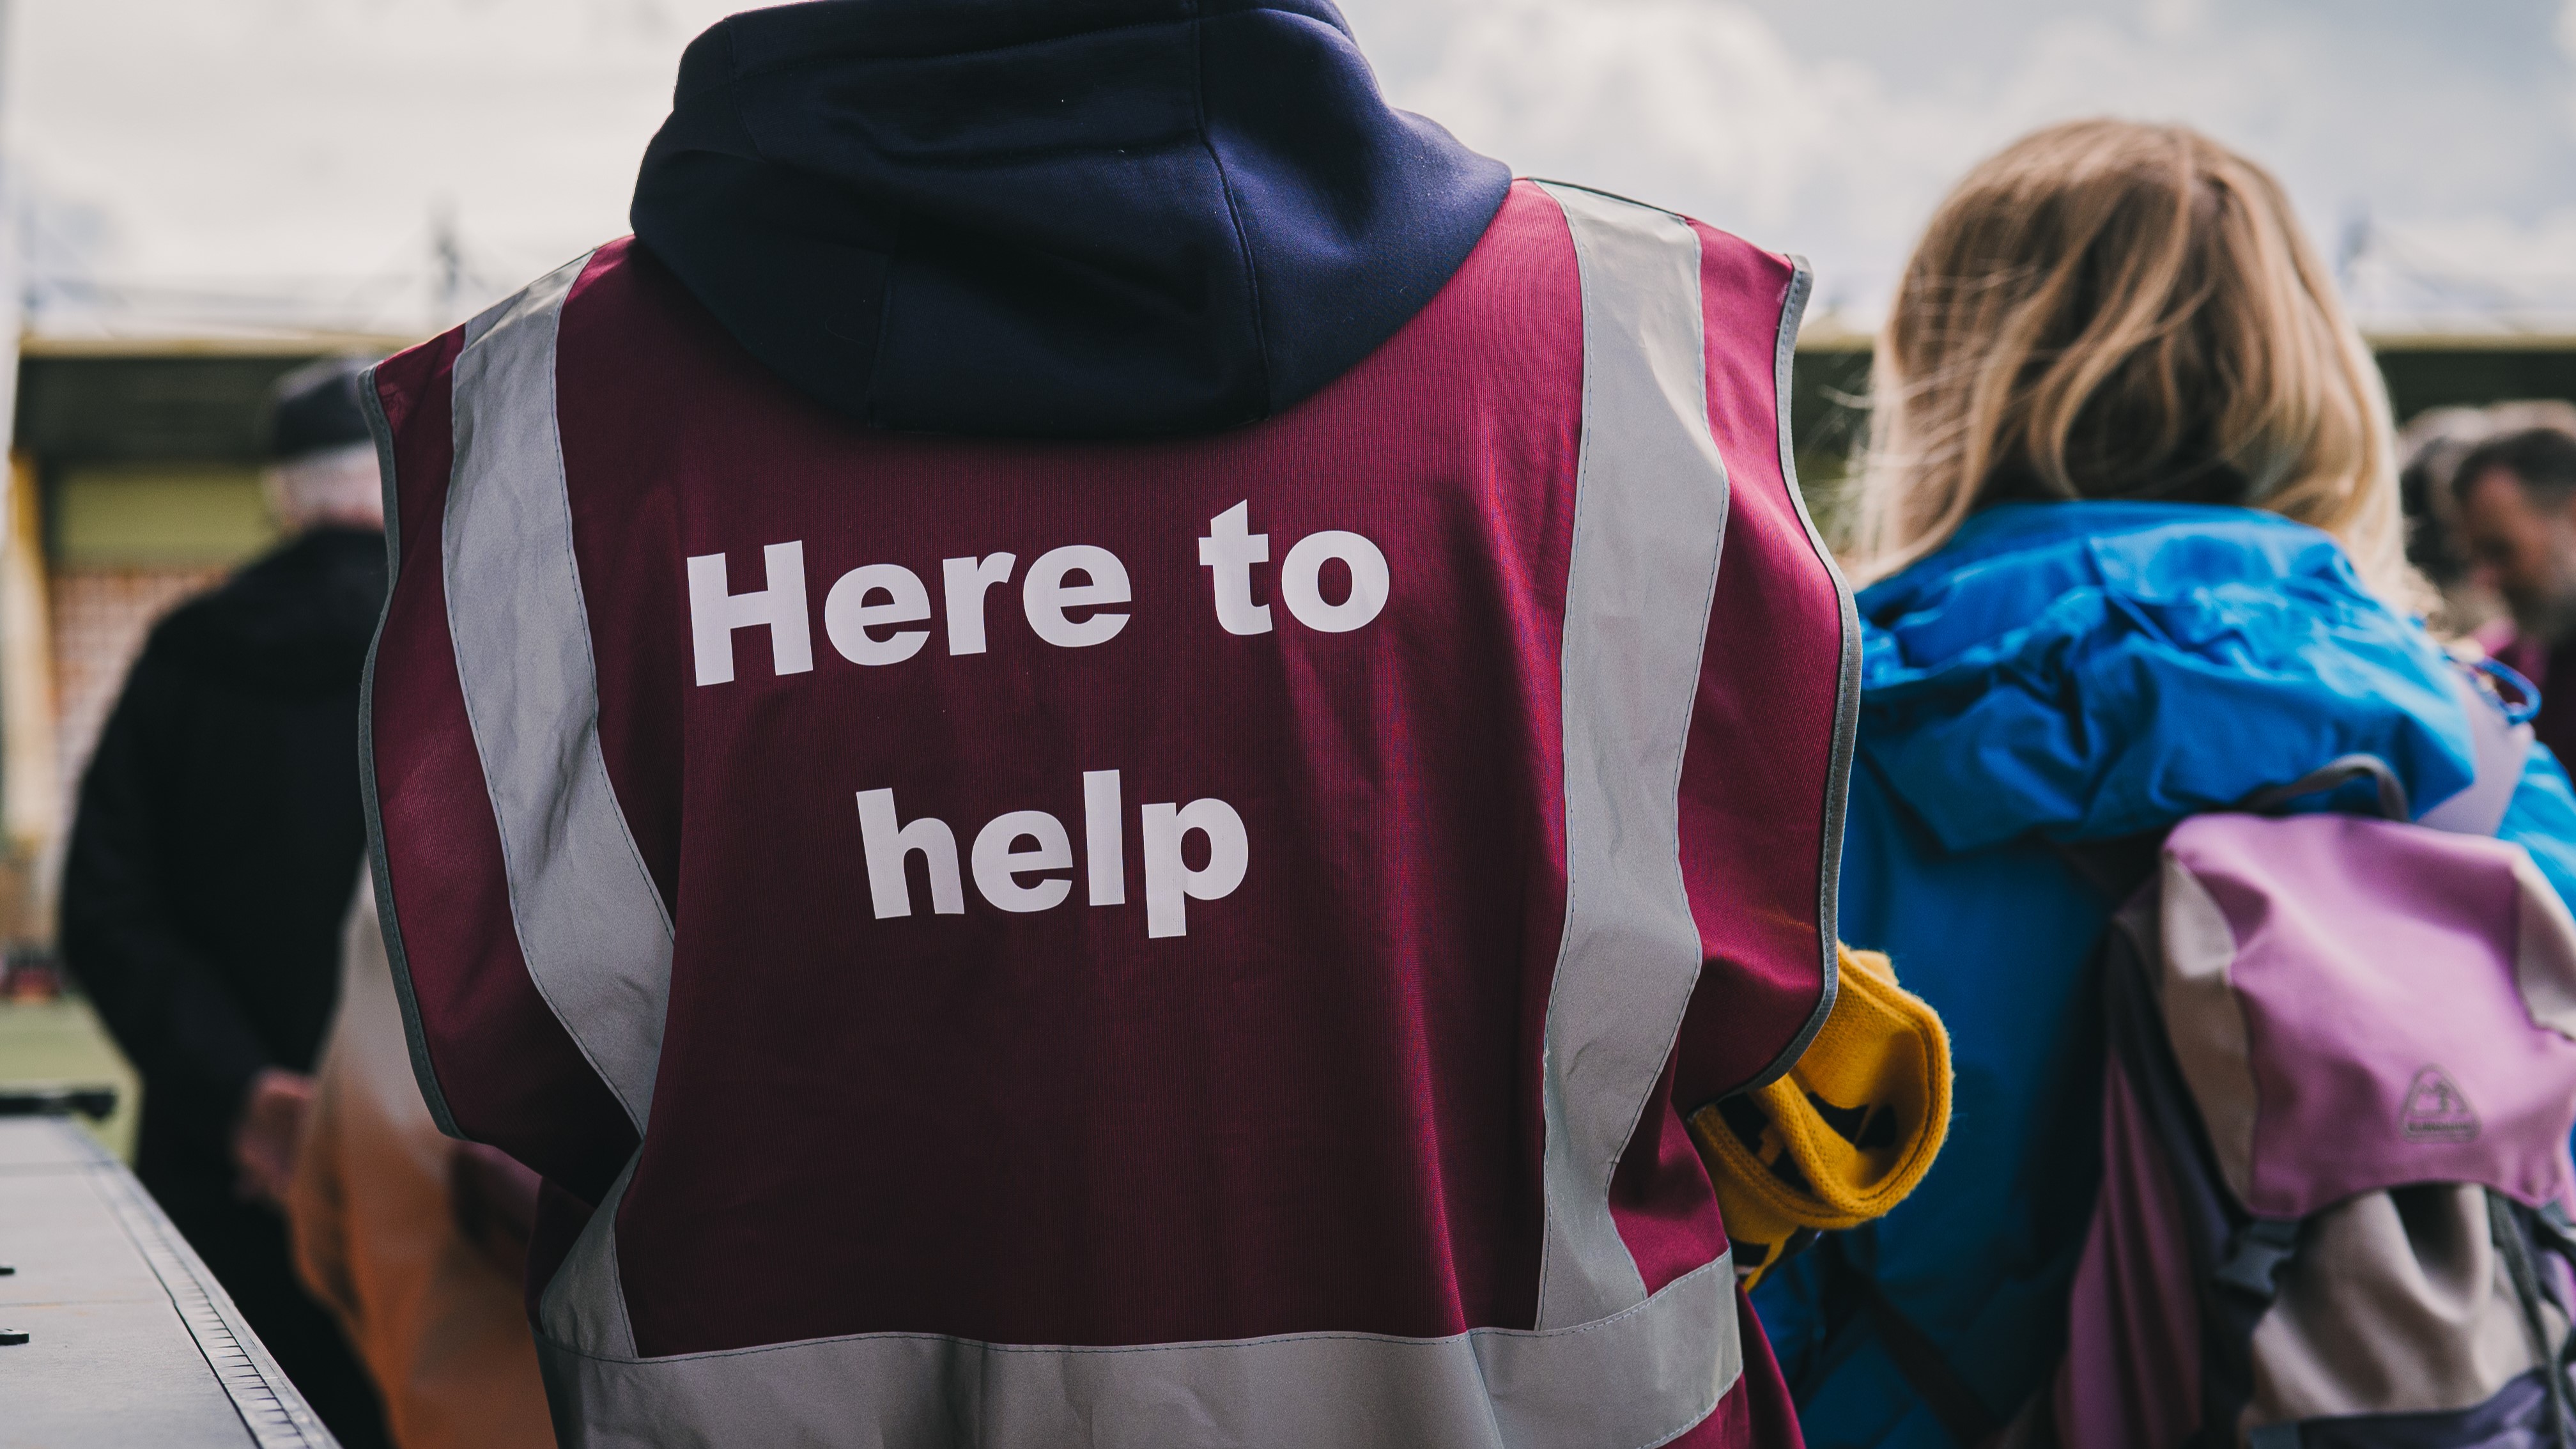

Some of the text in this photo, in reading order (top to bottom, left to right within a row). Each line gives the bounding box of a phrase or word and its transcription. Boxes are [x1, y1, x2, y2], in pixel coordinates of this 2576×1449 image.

[686, 499, 1391, 686] Here to
[856, 769, 1250, 939] help
